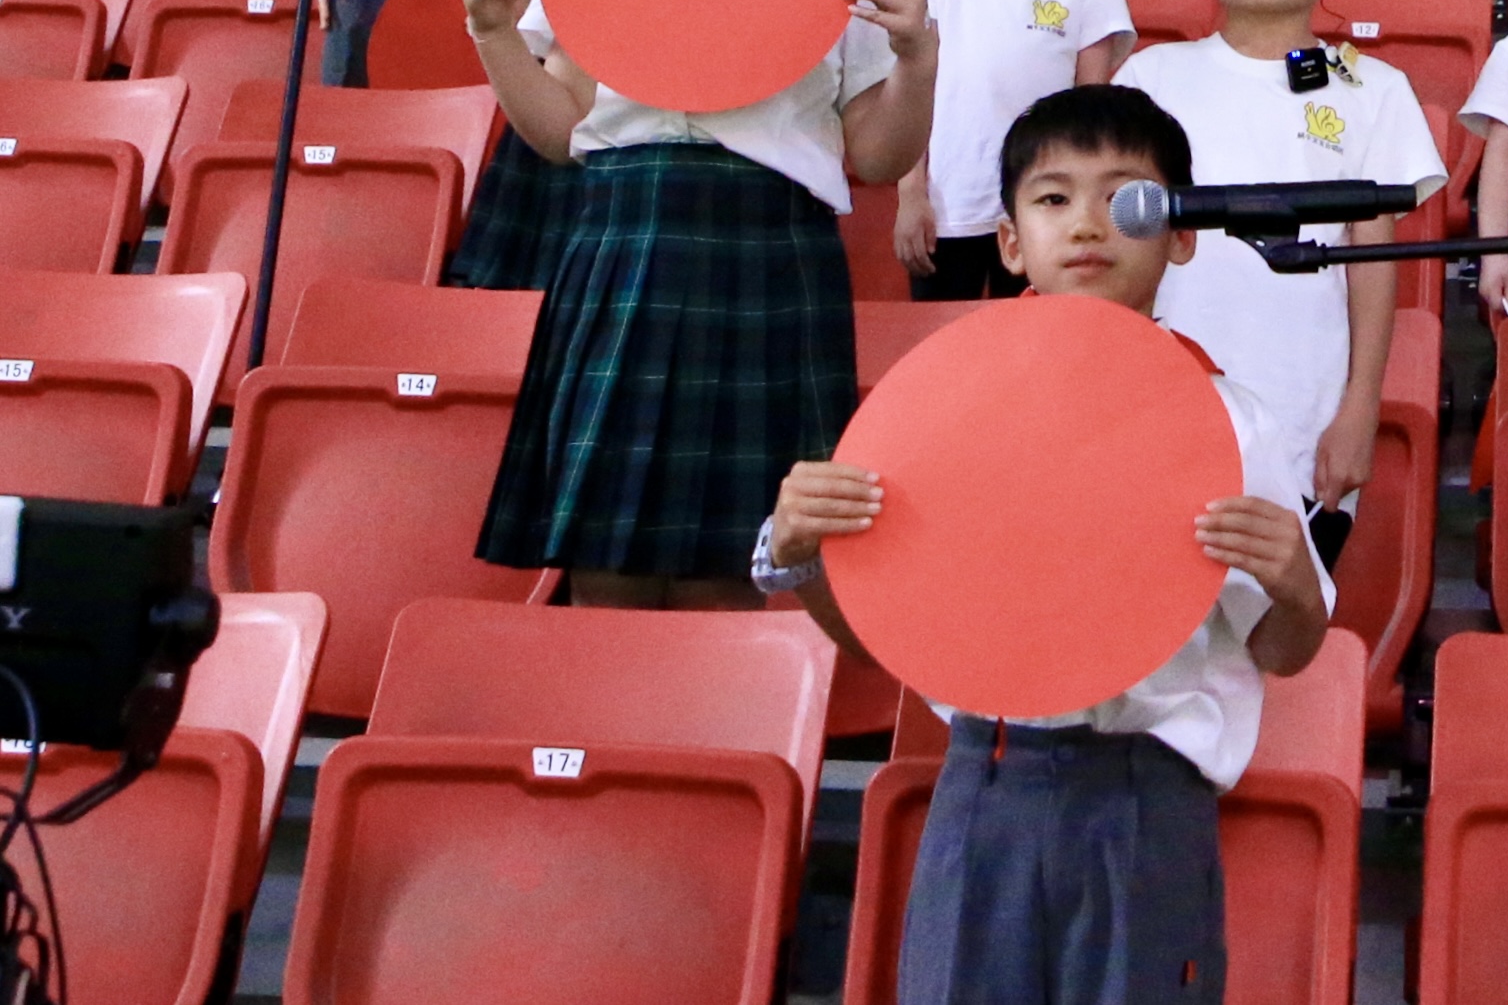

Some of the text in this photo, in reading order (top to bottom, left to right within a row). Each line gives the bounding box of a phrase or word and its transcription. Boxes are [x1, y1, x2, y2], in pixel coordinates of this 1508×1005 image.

[313, 149, 326, 161] 15
[5, 363, 21, 378] 15
[408, 378, 425, 392] 14
[547, 752, 570, 772] 17
